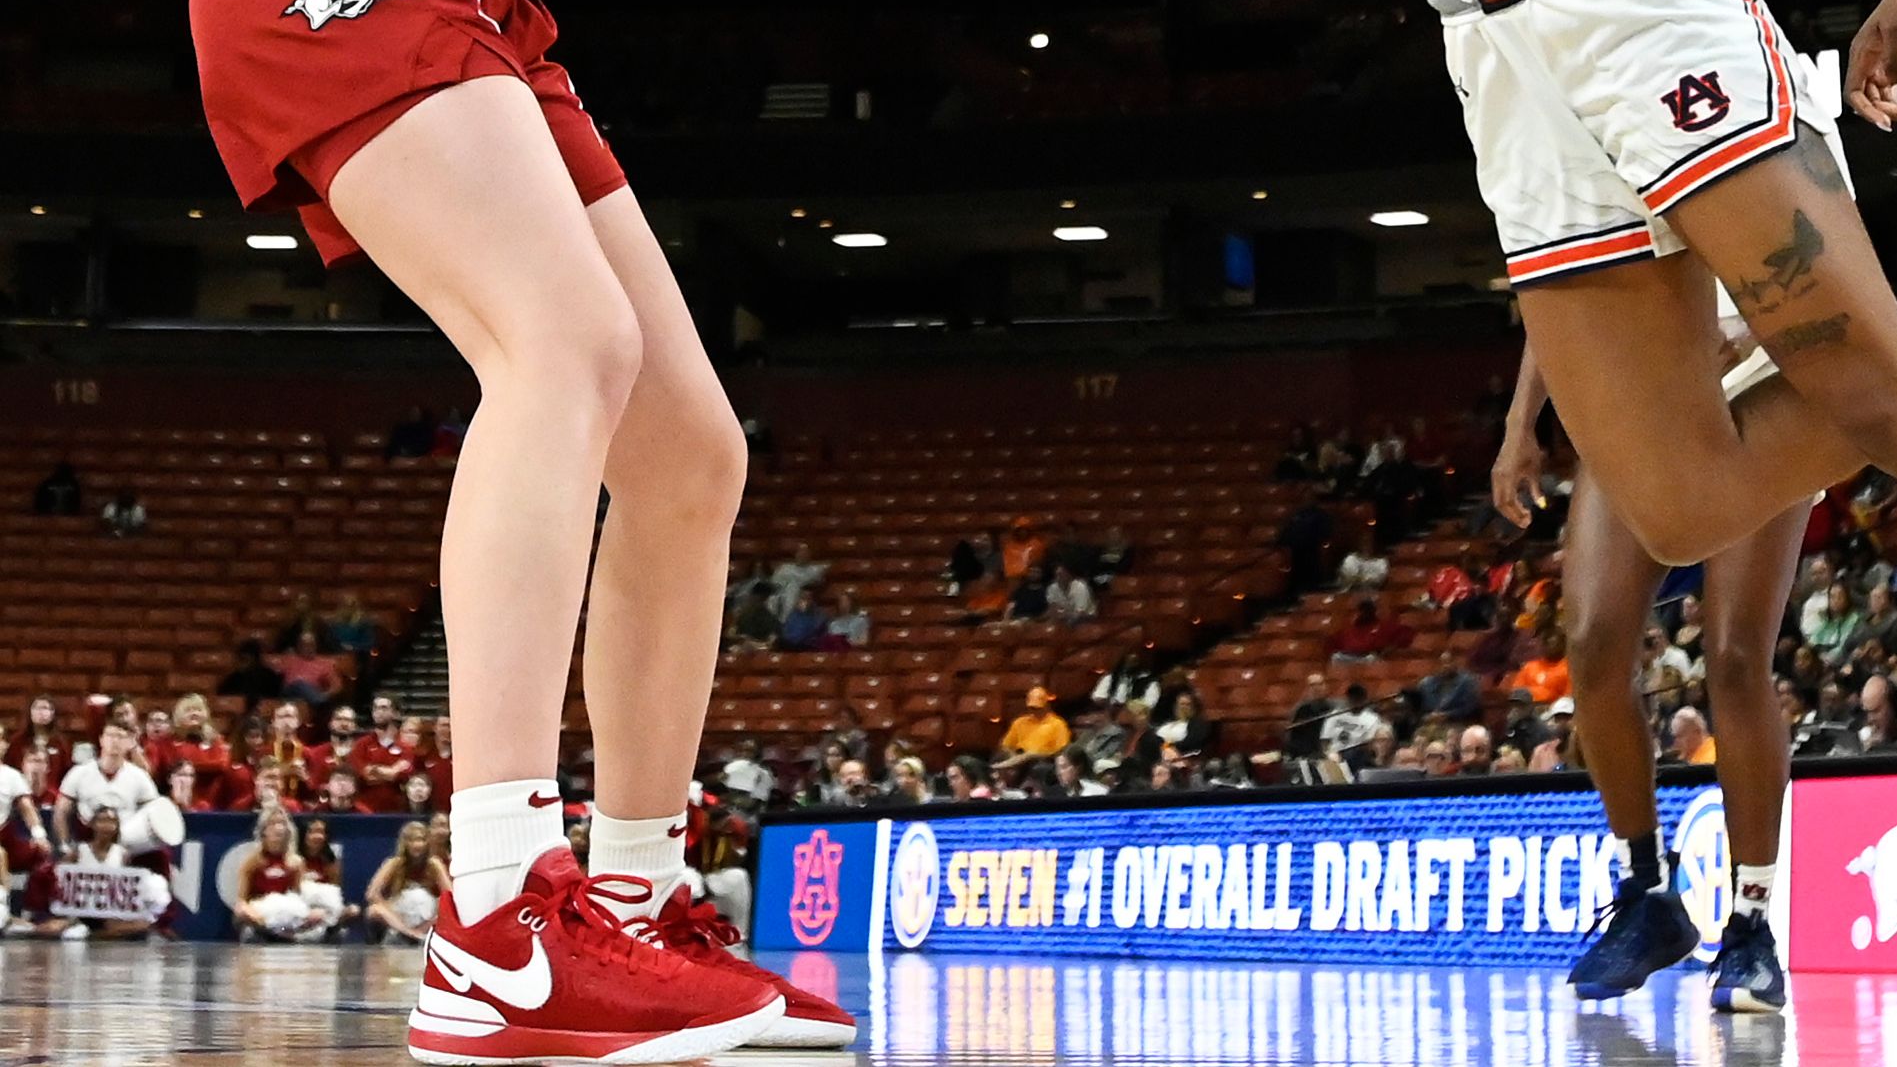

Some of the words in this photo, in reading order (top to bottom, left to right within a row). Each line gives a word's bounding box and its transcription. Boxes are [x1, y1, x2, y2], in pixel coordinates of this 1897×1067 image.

[62, 871, 140, 912] DEFENSE
[944, 849, 1059, 927] SEVEN
[1063, 846, 1104, 928] #1
[1112, 842, 1302, 930] OVERALL
[1310, 838, 1476, 932] DRAFT
